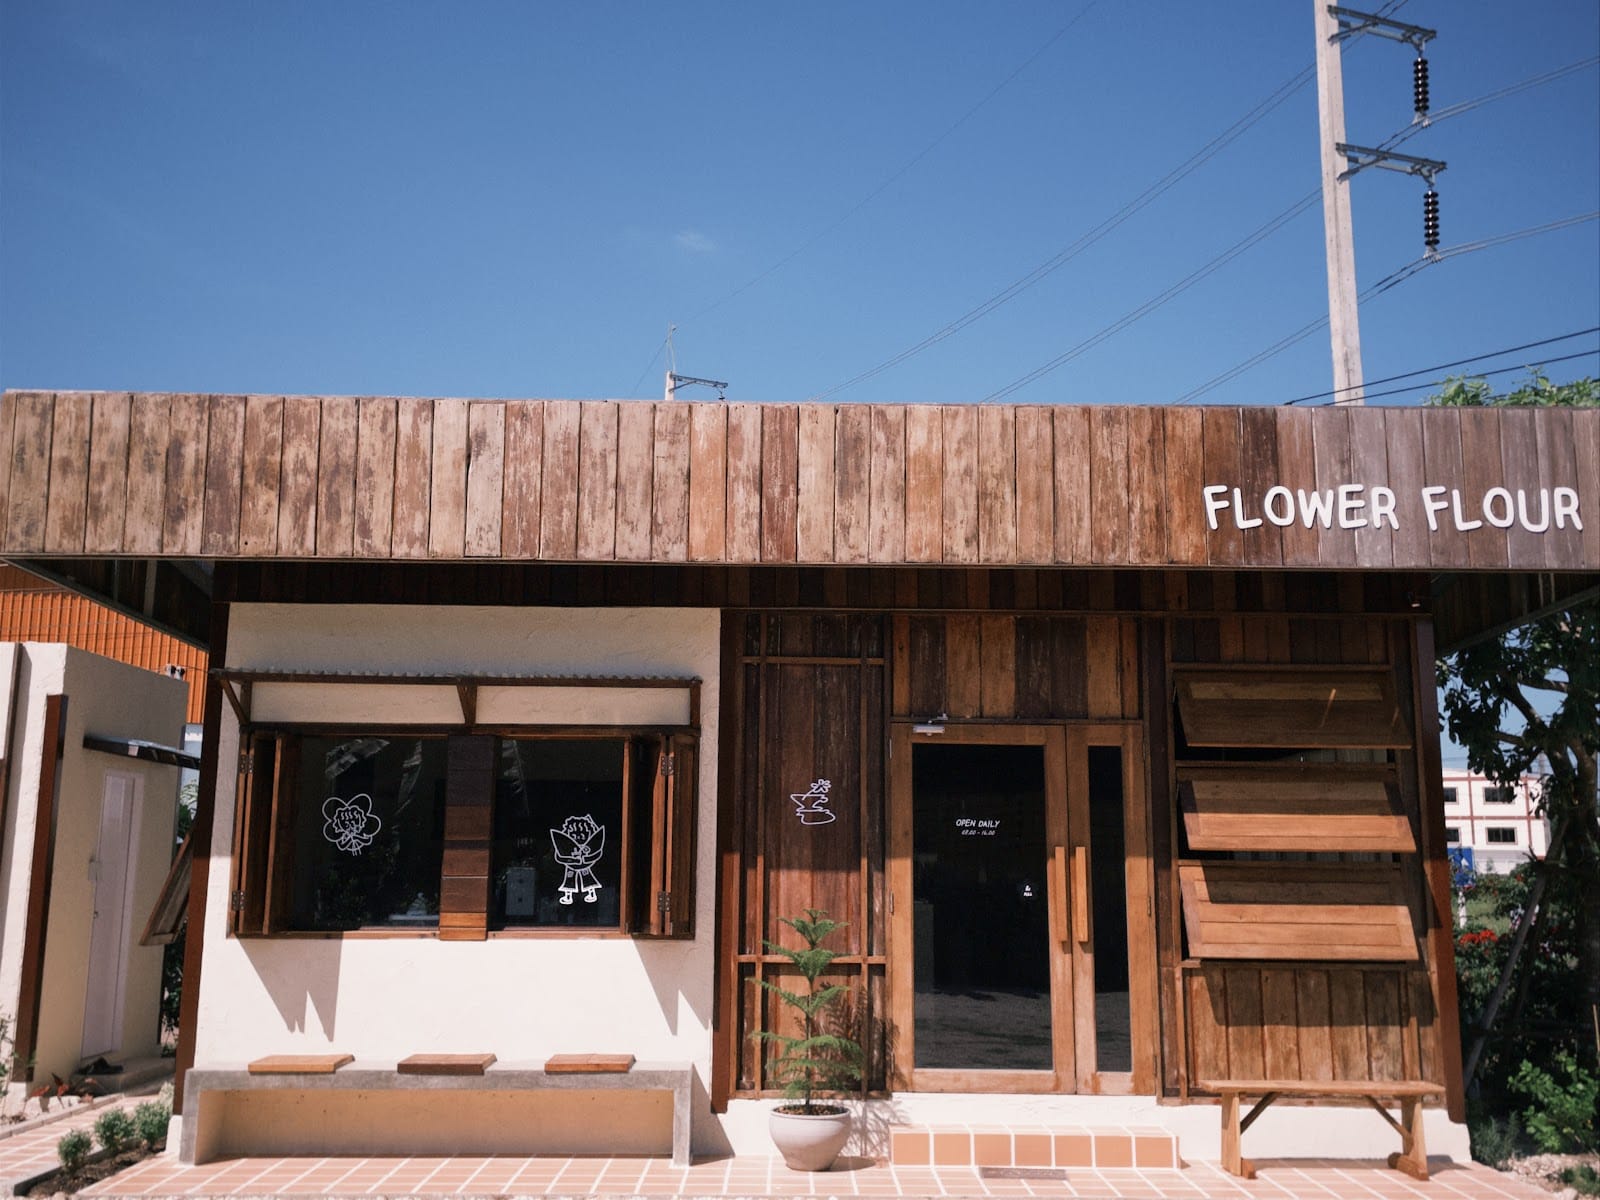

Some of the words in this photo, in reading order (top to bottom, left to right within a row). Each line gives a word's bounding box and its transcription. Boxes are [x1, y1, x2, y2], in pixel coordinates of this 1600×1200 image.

[1203, 484, 1400, 531] FLOWER
[1421, 485, 1583, 533] FLOUR
[955, 819, 976, 827] OPEN
[978, 820, 1000, 828] DAILY
